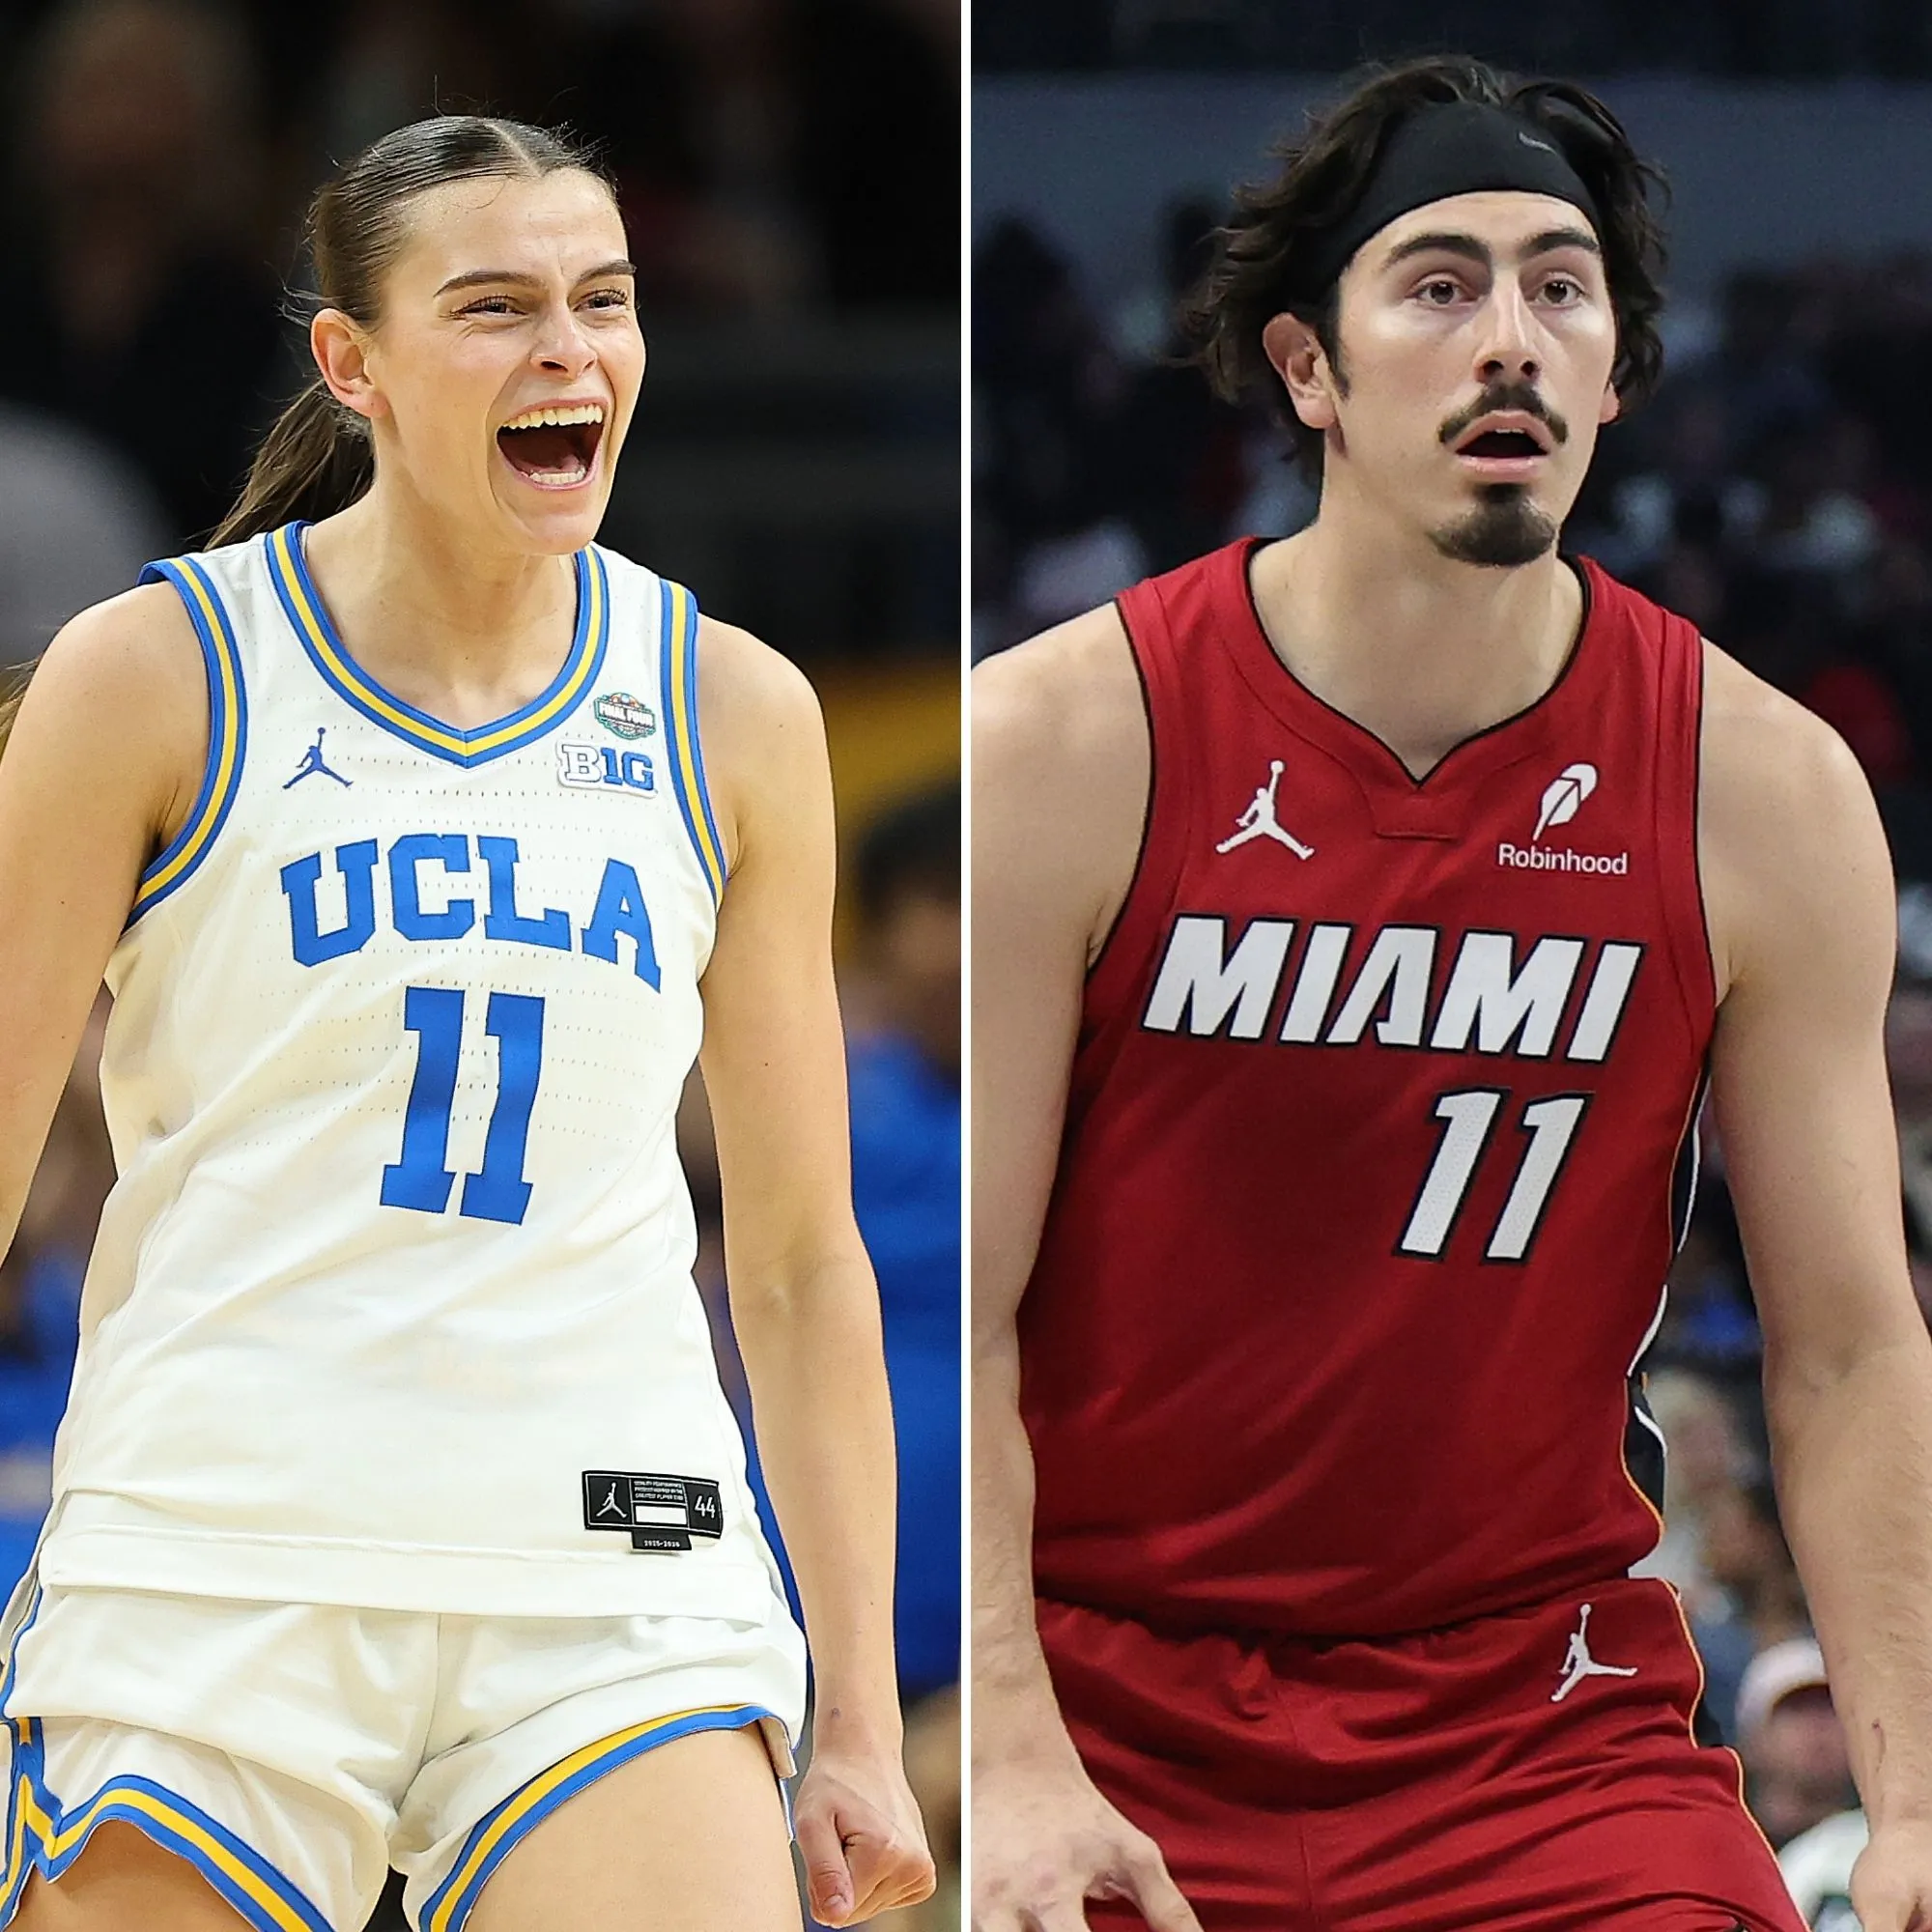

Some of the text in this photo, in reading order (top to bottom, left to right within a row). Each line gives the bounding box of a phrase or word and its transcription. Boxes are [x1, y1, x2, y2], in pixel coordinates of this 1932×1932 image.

[280, 834, 661, 993] UCLA
[1498, 843, 1628, 874] Robinhood
[1140, 914, 1646, 1064] MIAMI
[380, 986, 545, 1226] 11
[1394, 1088, 1594, 1264] 11
[695, 1495, 716, 1519] 44
